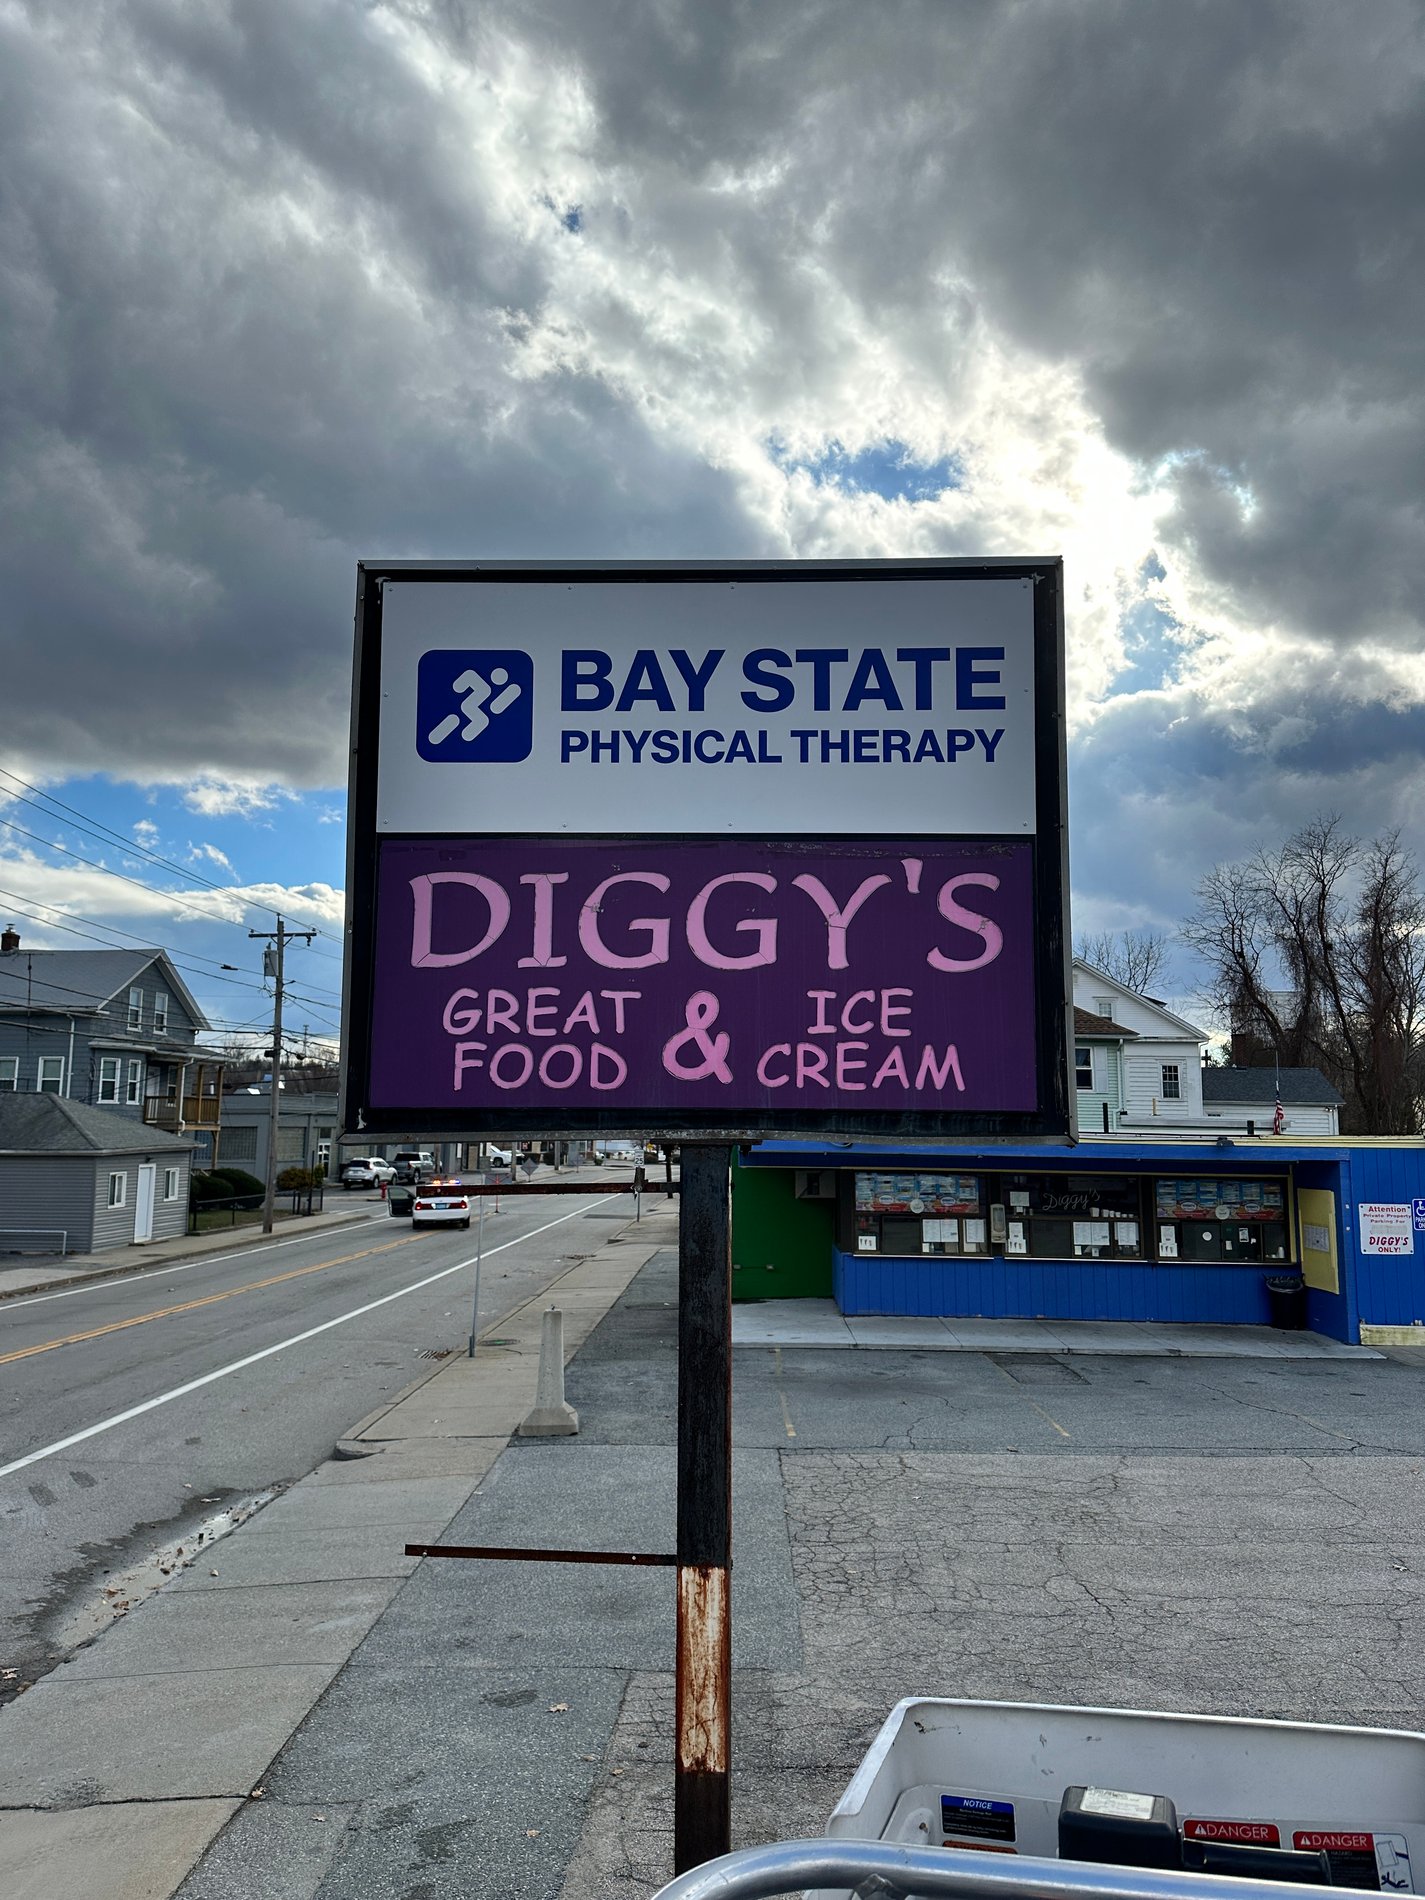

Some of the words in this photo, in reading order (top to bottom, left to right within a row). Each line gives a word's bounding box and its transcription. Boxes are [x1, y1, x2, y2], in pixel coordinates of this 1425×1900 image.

[560, 648, 726, 713] BAY
[740, 646, 1007, 713] STATE
[560, 730, 766, 765] PHYSICAL
[790, 728, 1007, 764] THERAPY
[408, 858, 1005, 975] DIGGY'S
[442, 987, 643, 1036] GREAT
[807, 988, 915, 1037] ICE
[661, 989, 733, 1086] &
[453, 1042, 629, 1092] FOOD
[756, 1042, 967, 1093] CREAM
[635, 1157, 644, 1165] 25
[1042, 1188, 1101, 1210] Diggy's
[1368, 1205, 1407, 1213] Attention
[1369, 1236, 1409, 1246] DIGGY'S
[963, 1799, 993, 1810] NOTICE
[1206, 1823, 1269, 1839] DANGER
[1311, 1834, 1367, 1848] DANGER
